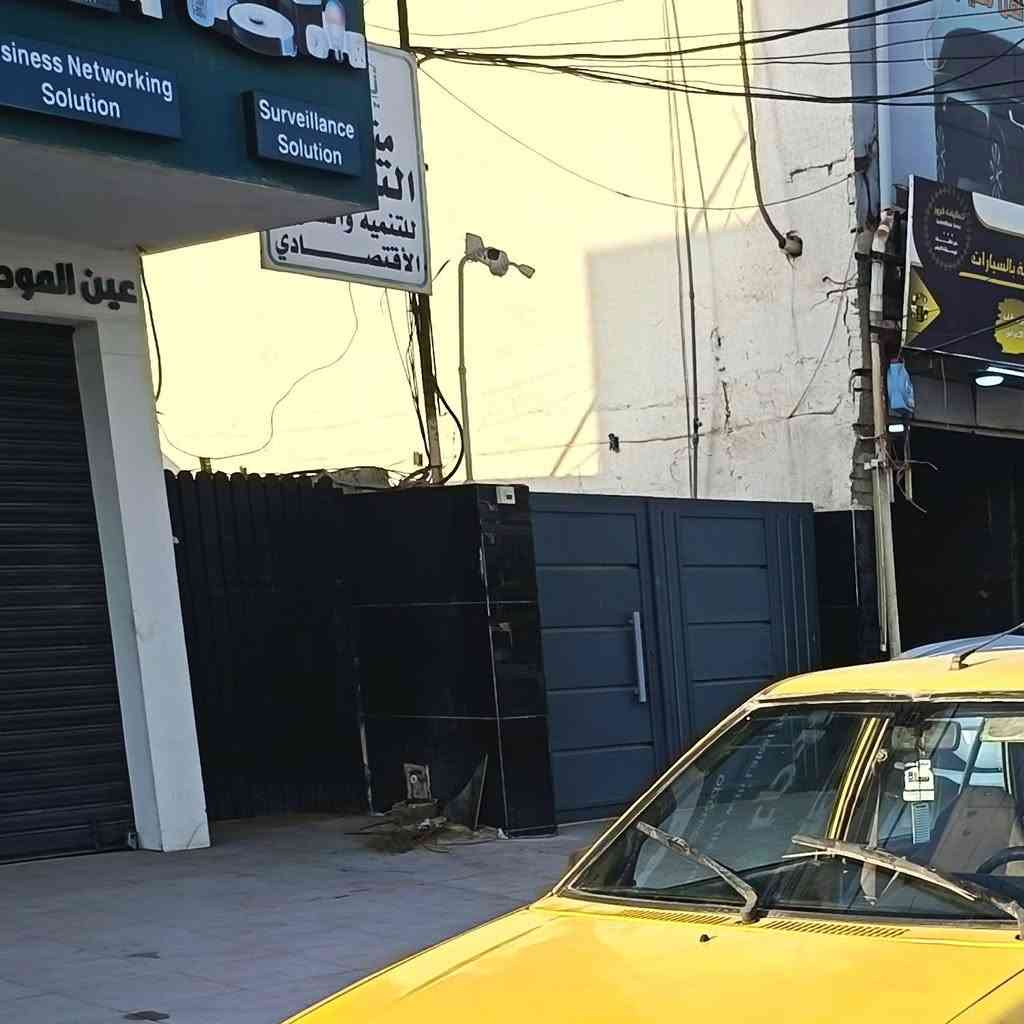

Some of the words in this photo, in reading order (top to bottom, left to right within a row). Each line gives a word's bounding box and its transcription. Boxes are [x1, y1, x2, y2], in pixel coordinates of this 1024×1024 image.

[67, 54, 173, 102] Networking
[41, 82, 121, 119] Solution
[258, 98, 355, 139] Surveillance
[277, 134, 343, 166] Solution
[970, 251, 1017, 277] بالسيارات
[81, 268, 138, 311] عين
